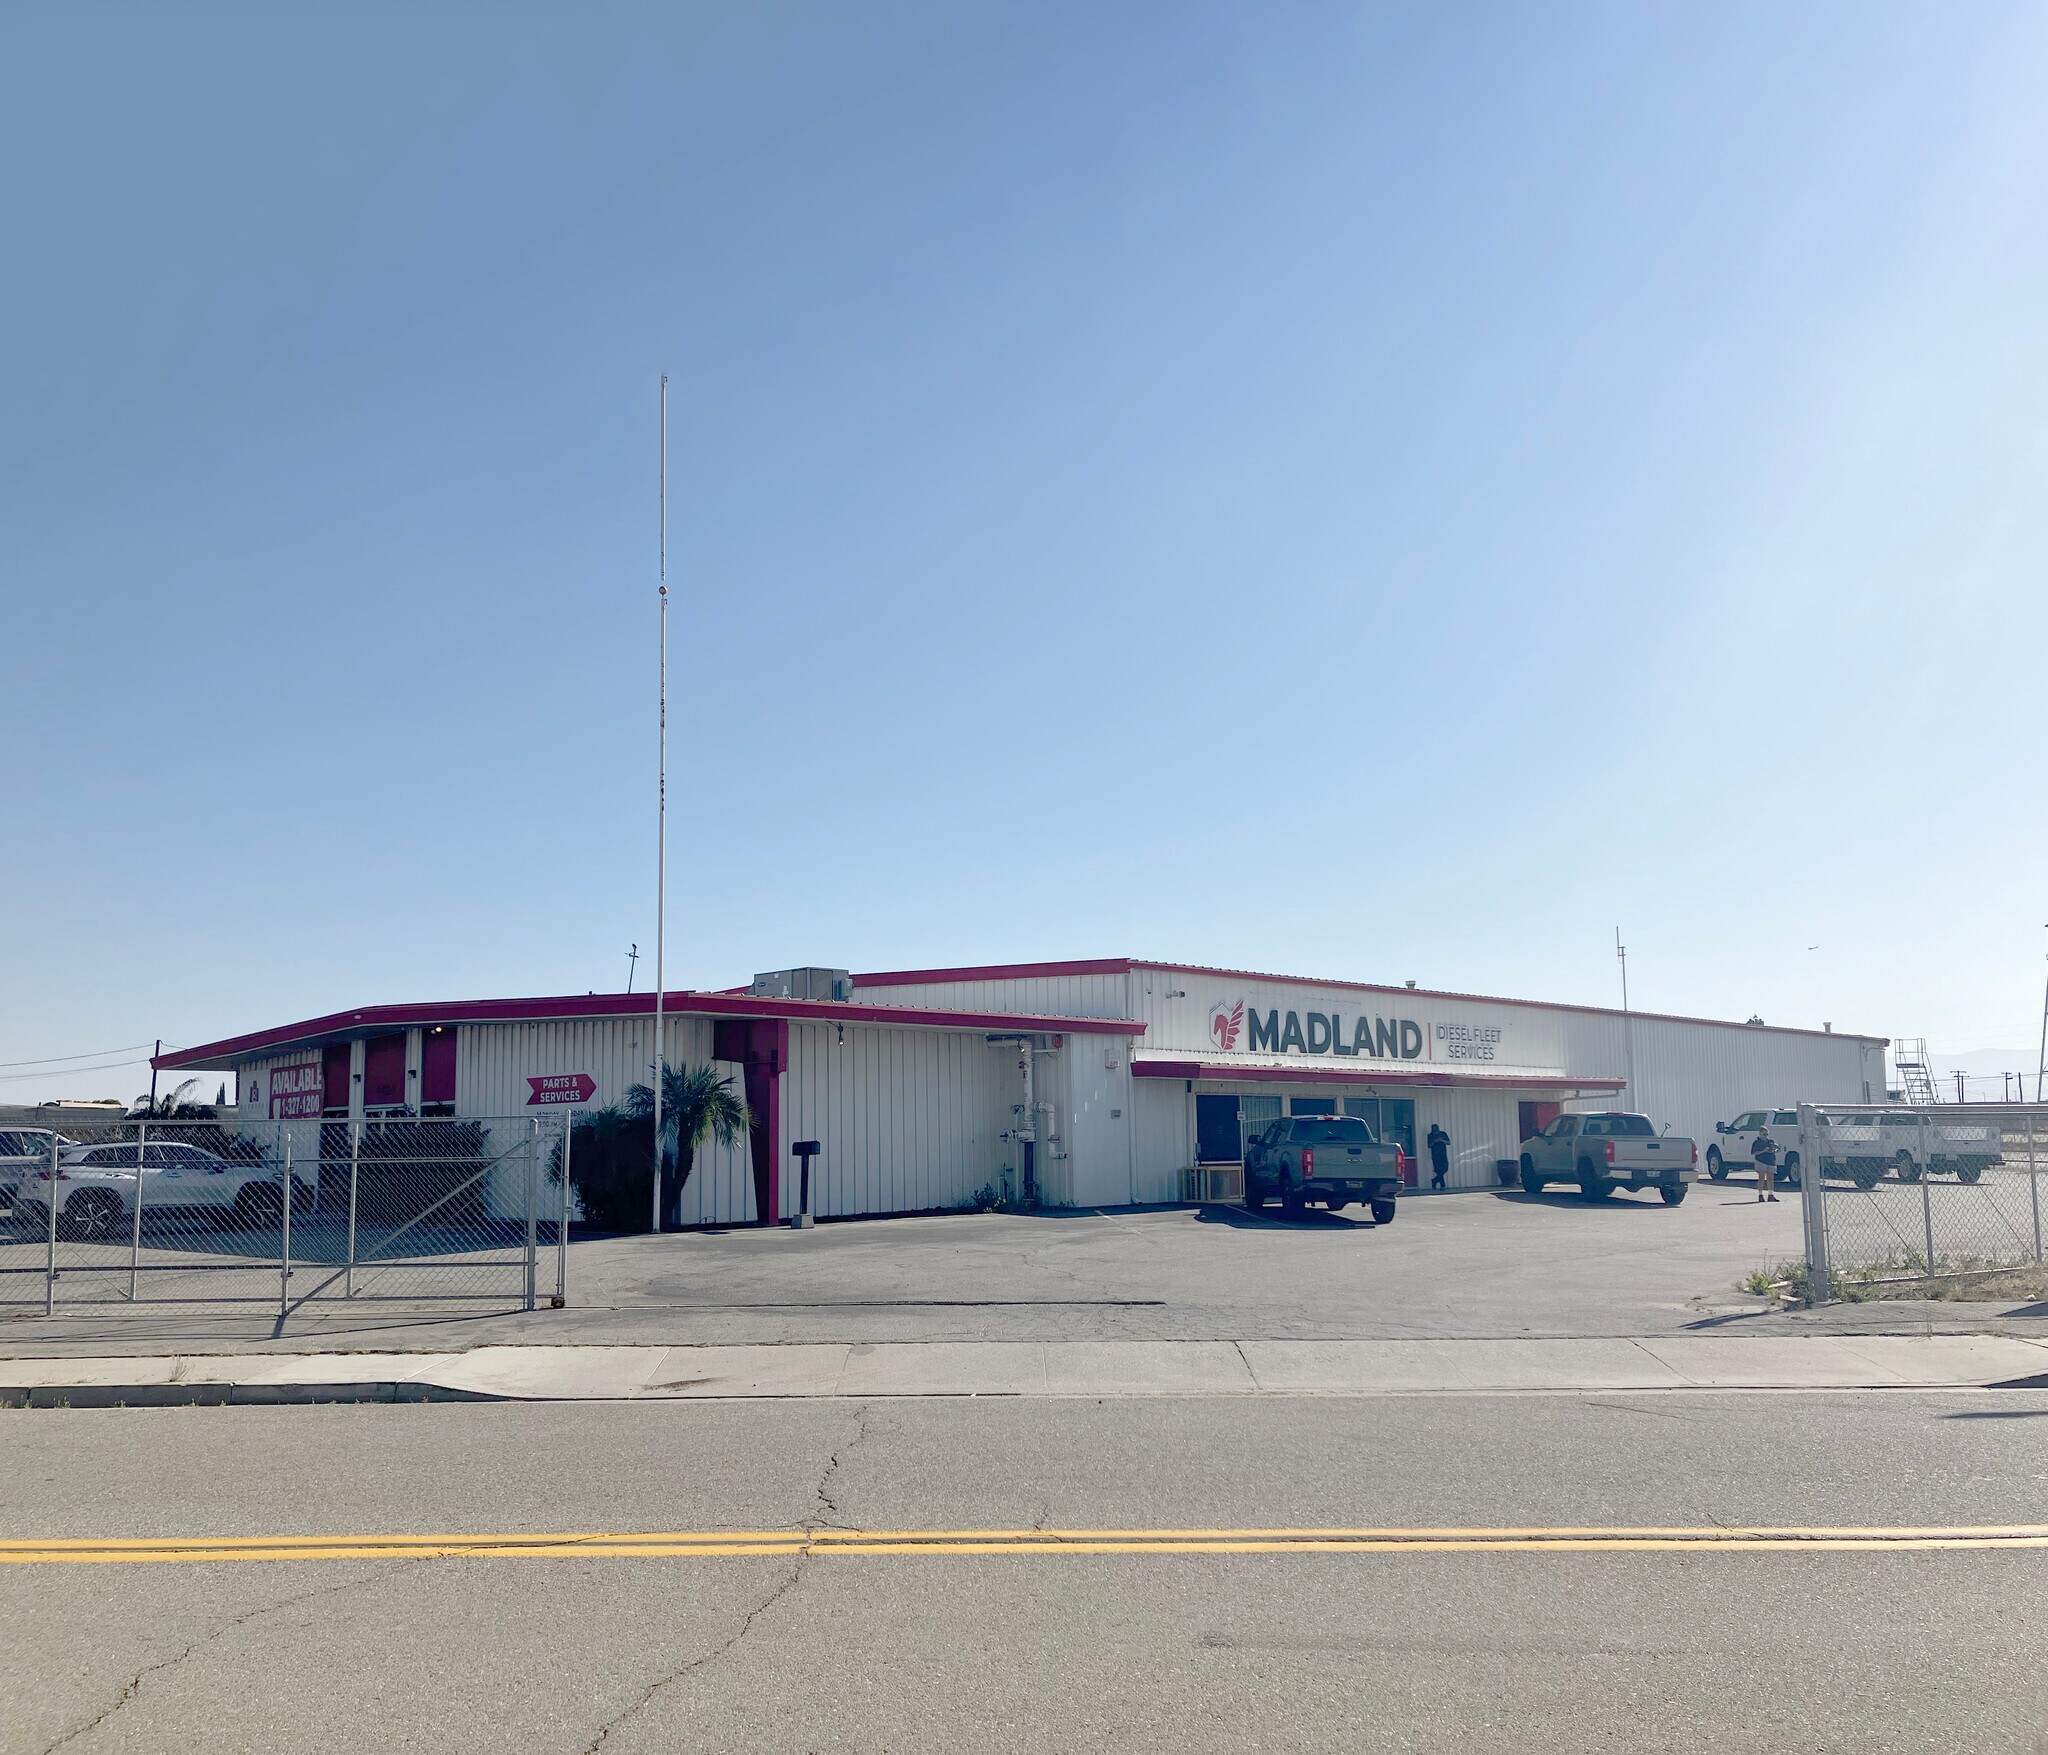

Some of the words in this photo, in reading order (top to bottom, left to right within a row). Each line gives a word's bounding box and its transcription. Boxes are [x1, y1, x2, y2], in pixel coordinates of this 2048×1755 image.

[1248, 1008, 1422, 1059] MADLAND
[1437, 1025, 1473, 1042] DIESEL
[1473, 1027, 1502, 1043] FLEET
[1448, 1044, 1495, 1061] SERVICES
[272, 1066, 322, 1095] AVAILABLE
[543, 1078, 570, 1089] PARTS
[572, 1077, 577, 1087] &
[540, 1090, 580, 1102] SERVICES
